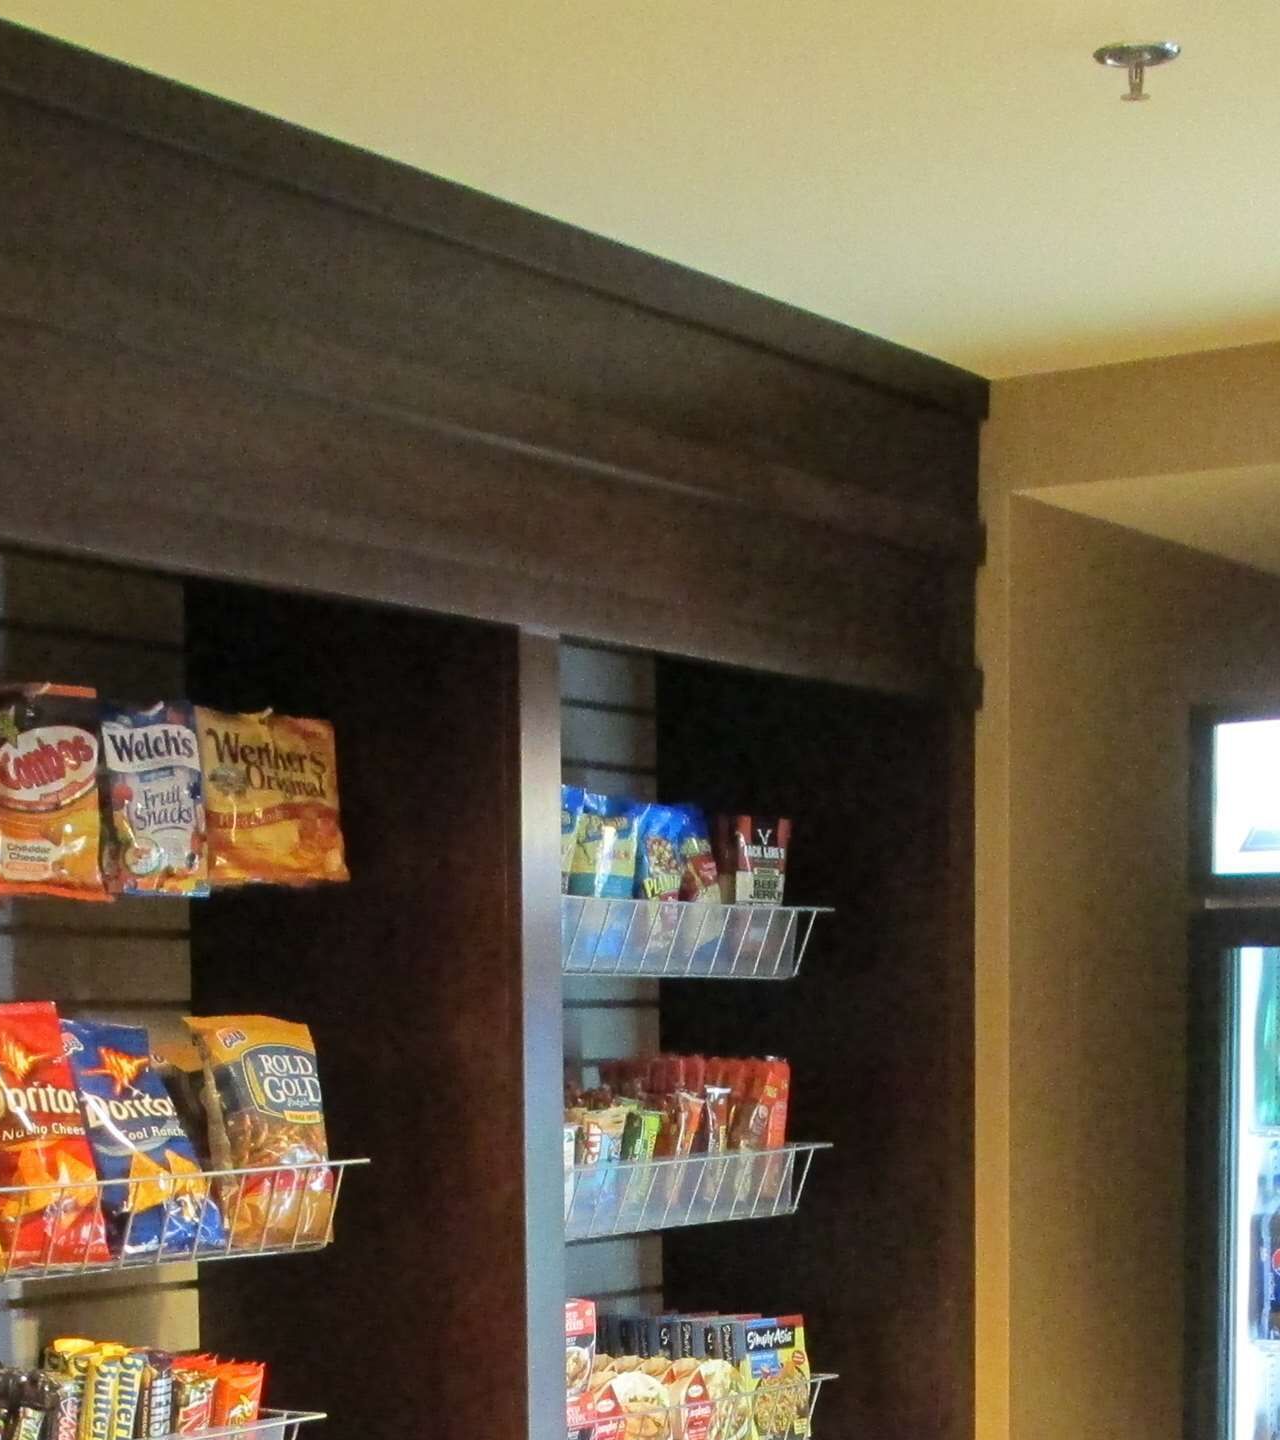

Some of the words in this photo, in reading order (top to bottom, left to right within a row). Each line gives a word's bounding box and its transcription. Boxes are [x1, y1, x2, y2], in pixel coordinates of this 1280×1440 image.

[108, 725, 195, 764] Welch's
[205, 727, 327, 775] Werther's
[246, 763, 327, 800] Original
[143, 785, 183, 809] Fruit
[134, 804, 194, 832] Snacks
[6, 842, 51, 855] Cheddar
[8, 852, 50, 863] Cheese
[753, 879, 779, 890] BEEF
[261, 1053, 315, 1077] ROLD
[263, 1077, 322, 1104] GOLD
[152, 1124, 186, 1139] Ranch
[747, 1330, 775, 1350] Simply
[774, 1326, 794, 1344] Asia
